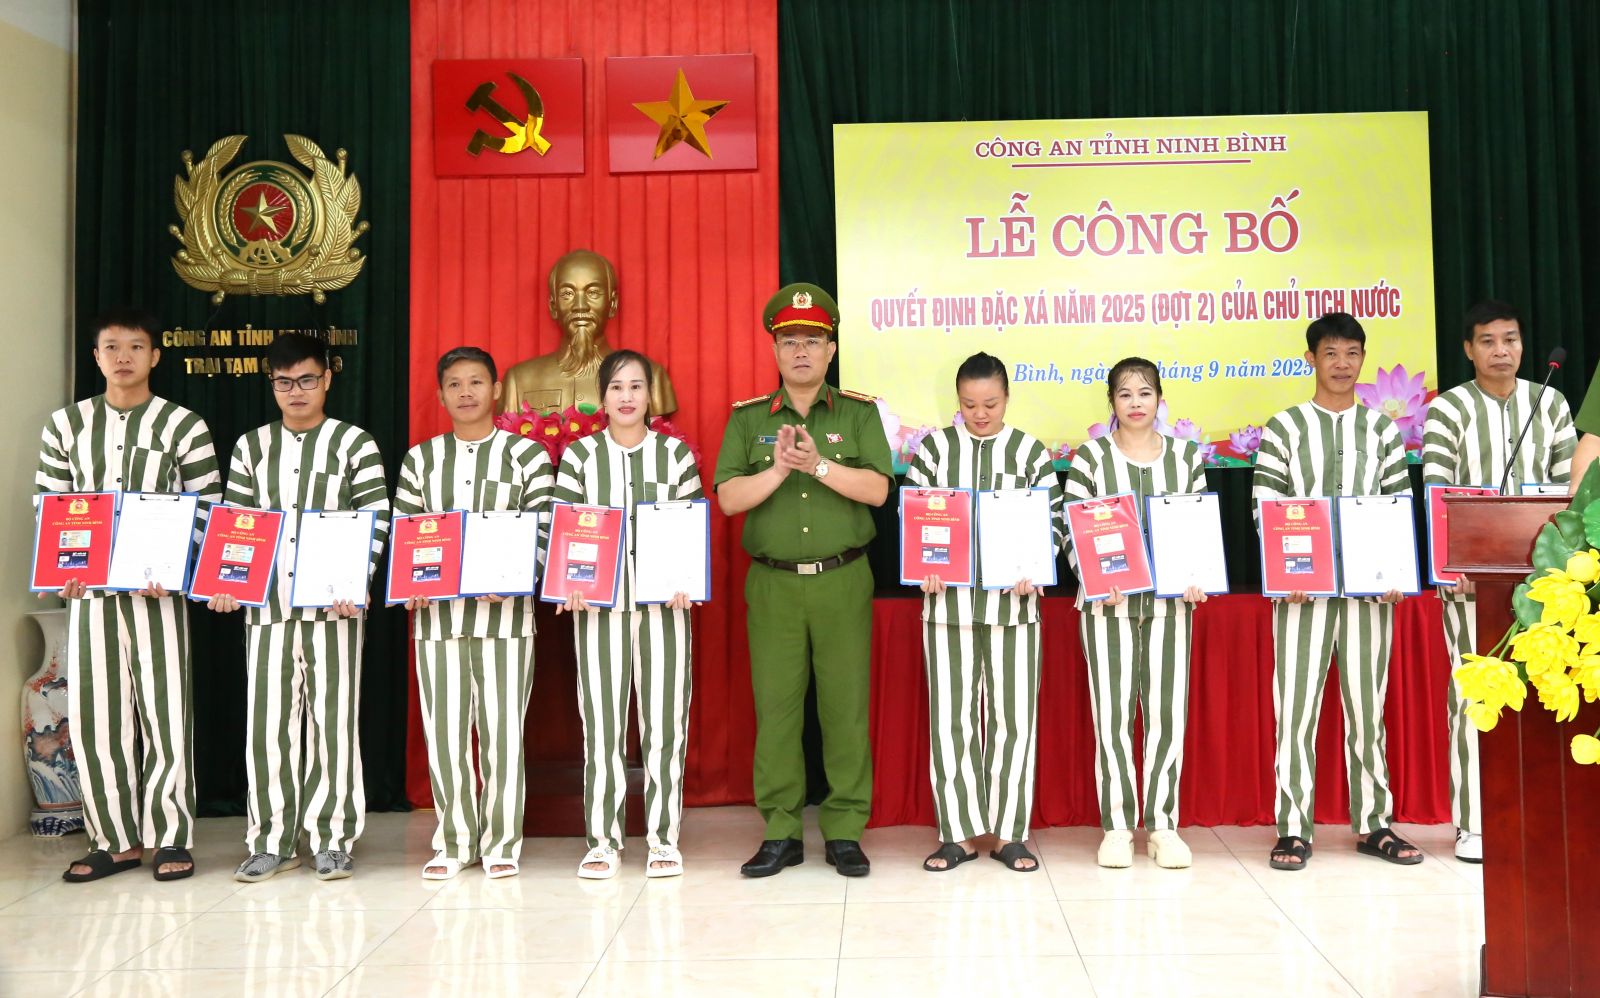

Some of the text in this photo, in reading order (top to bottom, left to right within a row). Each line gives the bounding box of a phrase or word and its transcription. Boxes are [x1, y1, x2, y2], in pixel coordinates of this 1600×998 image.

[975, 133, 1287, 158] CÔNG AN TỈNH NINH BÌNH
[965, 189, 1300, 258] LỄ CÔNG BỐ
[871, 287, 926, 331] QUYẾT
[932, 297, 976, 333] ĐỊNH
[981, 290, 1018, 332] ĐẶC
[1024, 290, 1048, 325] XÁ
[1053, 289, 1096, 324] NĂM
[1102, 294, 1145, 323] 2025
[1152, 290, 1192, 328] (ĐỢT
[1198, 292, 1215, 324] 2)
[1221, 279, 1258, 321] CỦA
[1263, 278, 1299, 320] CHỦ
[1351, 280, 1401, 318] NƯỚC
[162, 326, 206, 348] CÔNG
[210, 329, 232, 347] AN
[237, 324, 274, 346] TỈNH
[184, 357, 221, 377] TRẠI
[224, 357, 259, 377] TẠM
[1013, 363, 1064, 384] Bình,
[1157, 360, 1203, 382] háng
[1208, 361, 1220, 378] 9
[1225, 361, 1267, 378] năm
[1271, 359, 1314, 376] 2025
